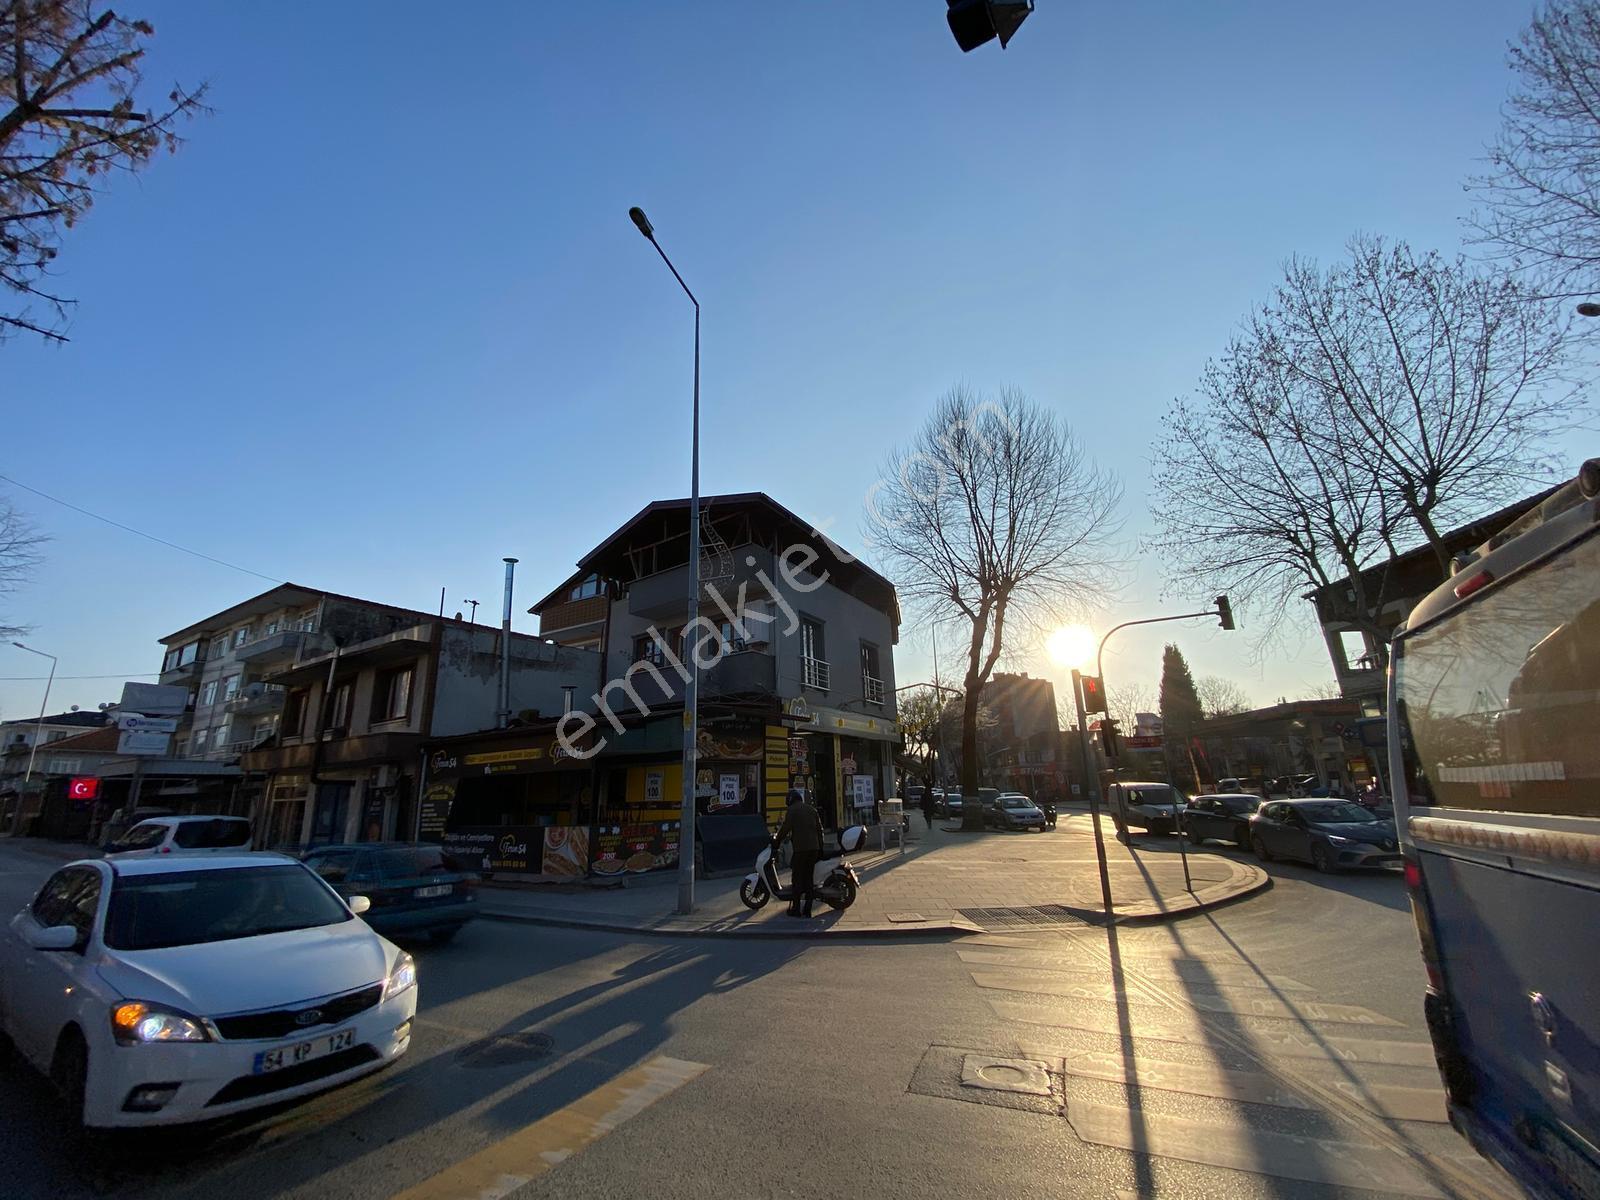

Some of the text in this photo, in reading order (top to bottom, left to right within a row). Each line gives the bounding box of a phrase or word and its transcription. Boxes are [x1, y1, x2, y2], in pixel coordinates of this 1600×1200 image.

[722, 790, 735, 801] 100
[263, 1050, 284, 1071] 54
[328, 1031, 353, 1052] 124
